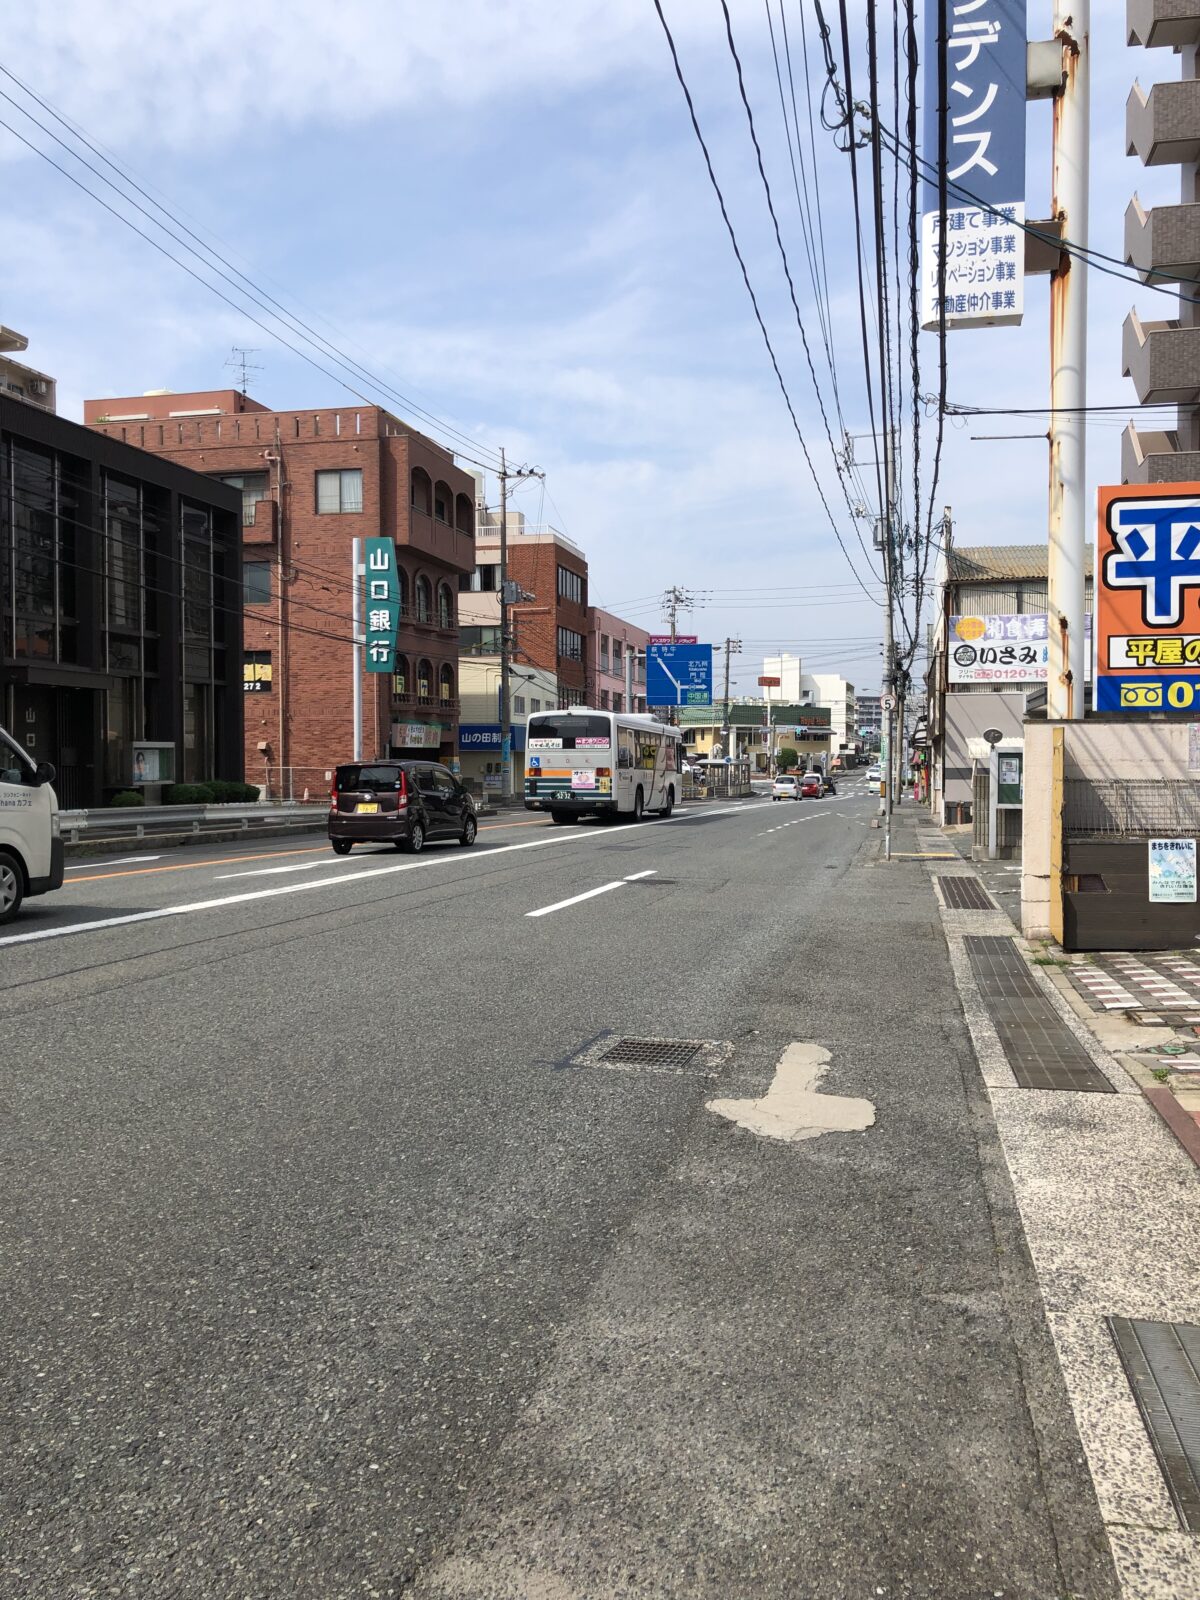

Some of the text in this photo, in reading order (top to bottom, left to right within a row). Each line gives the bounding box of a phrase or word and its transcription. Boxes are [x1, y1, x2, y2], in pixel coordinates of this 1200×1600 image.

[931, 260, 1016, 287] リベーション事業
[369, 548, 390, 662] 山口銀行
[979, 646, 1038, 665] いさみ
[1151, 842, 1193, 850] まちをきれいに
